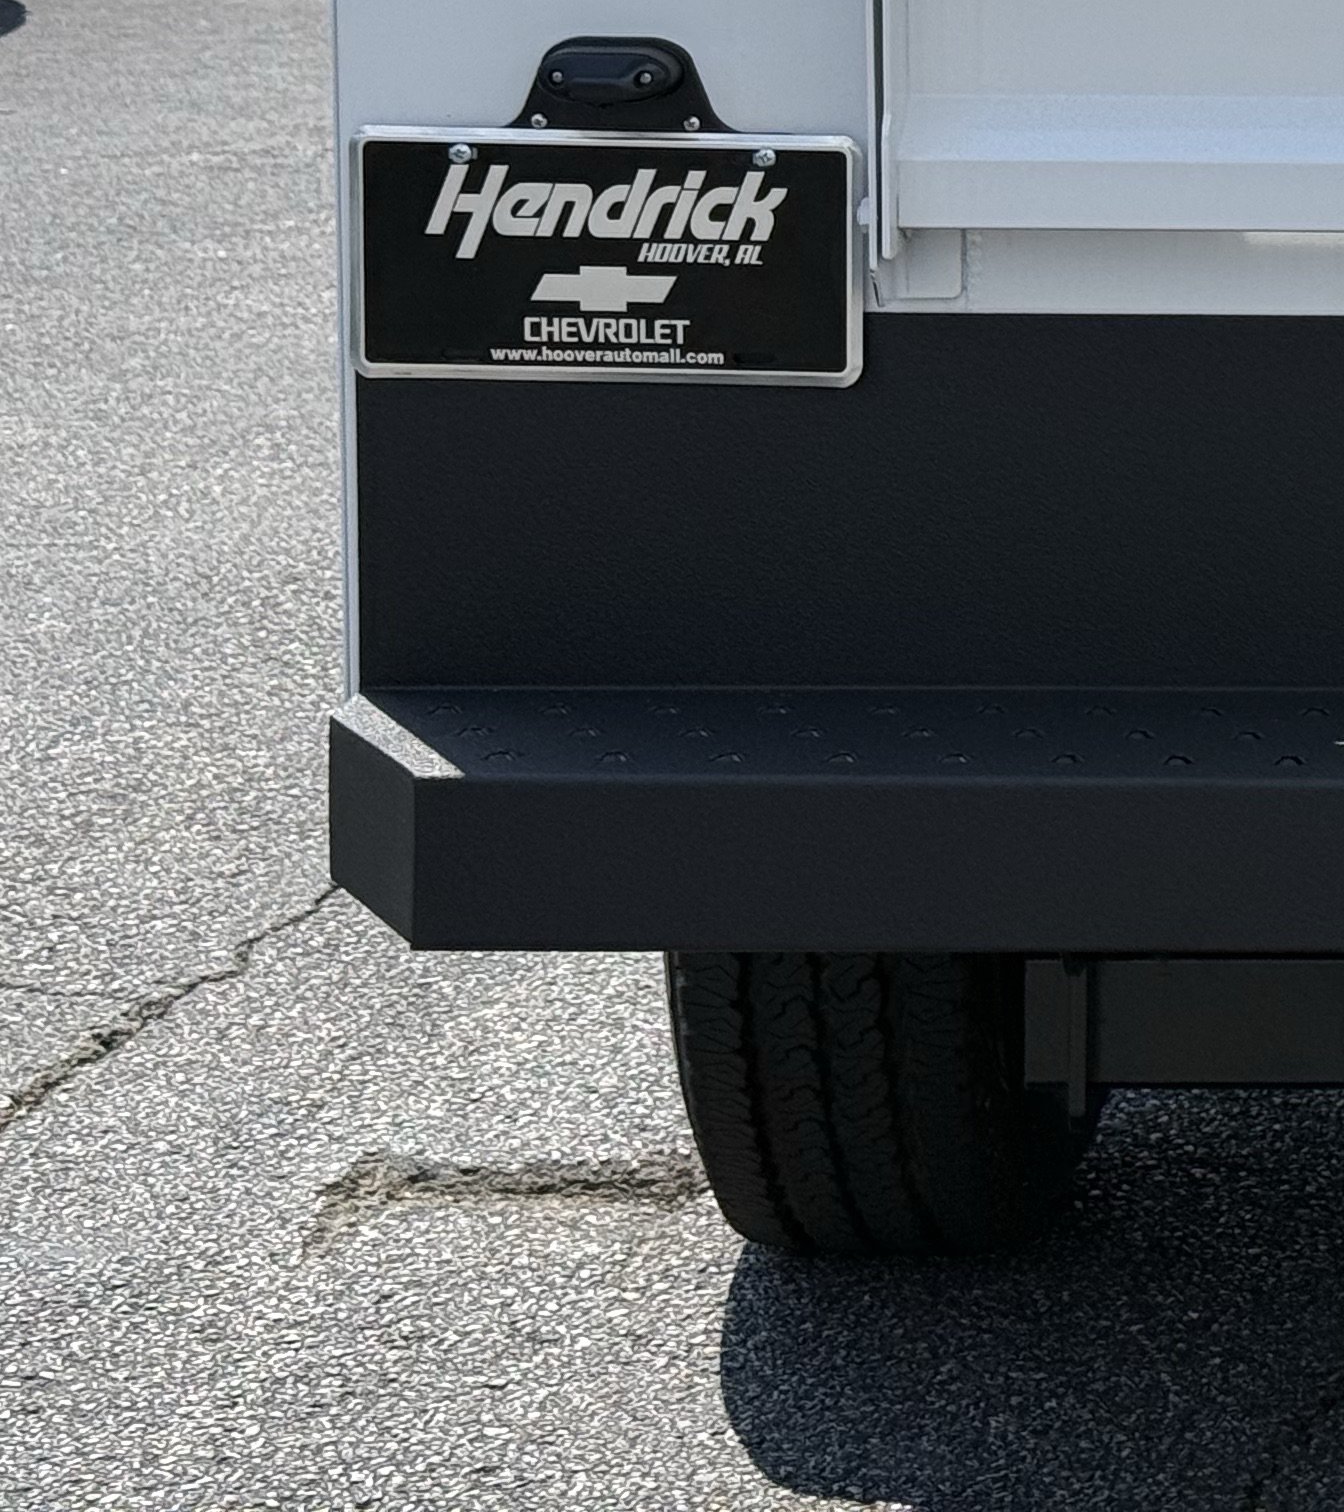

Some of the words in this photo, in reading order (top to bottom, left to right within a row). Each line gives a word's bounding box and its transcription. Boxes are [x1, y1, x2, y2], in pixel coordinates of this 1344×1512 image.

[425, 164, 788, 259] Hendrick
[637, 243, 731, 267] HOOVER,
[734, 245, 764, 265] AL
[523, 317, 691, 345] CHEVROLET
[490, 346, 725, 366] www.hooverautomall.com
